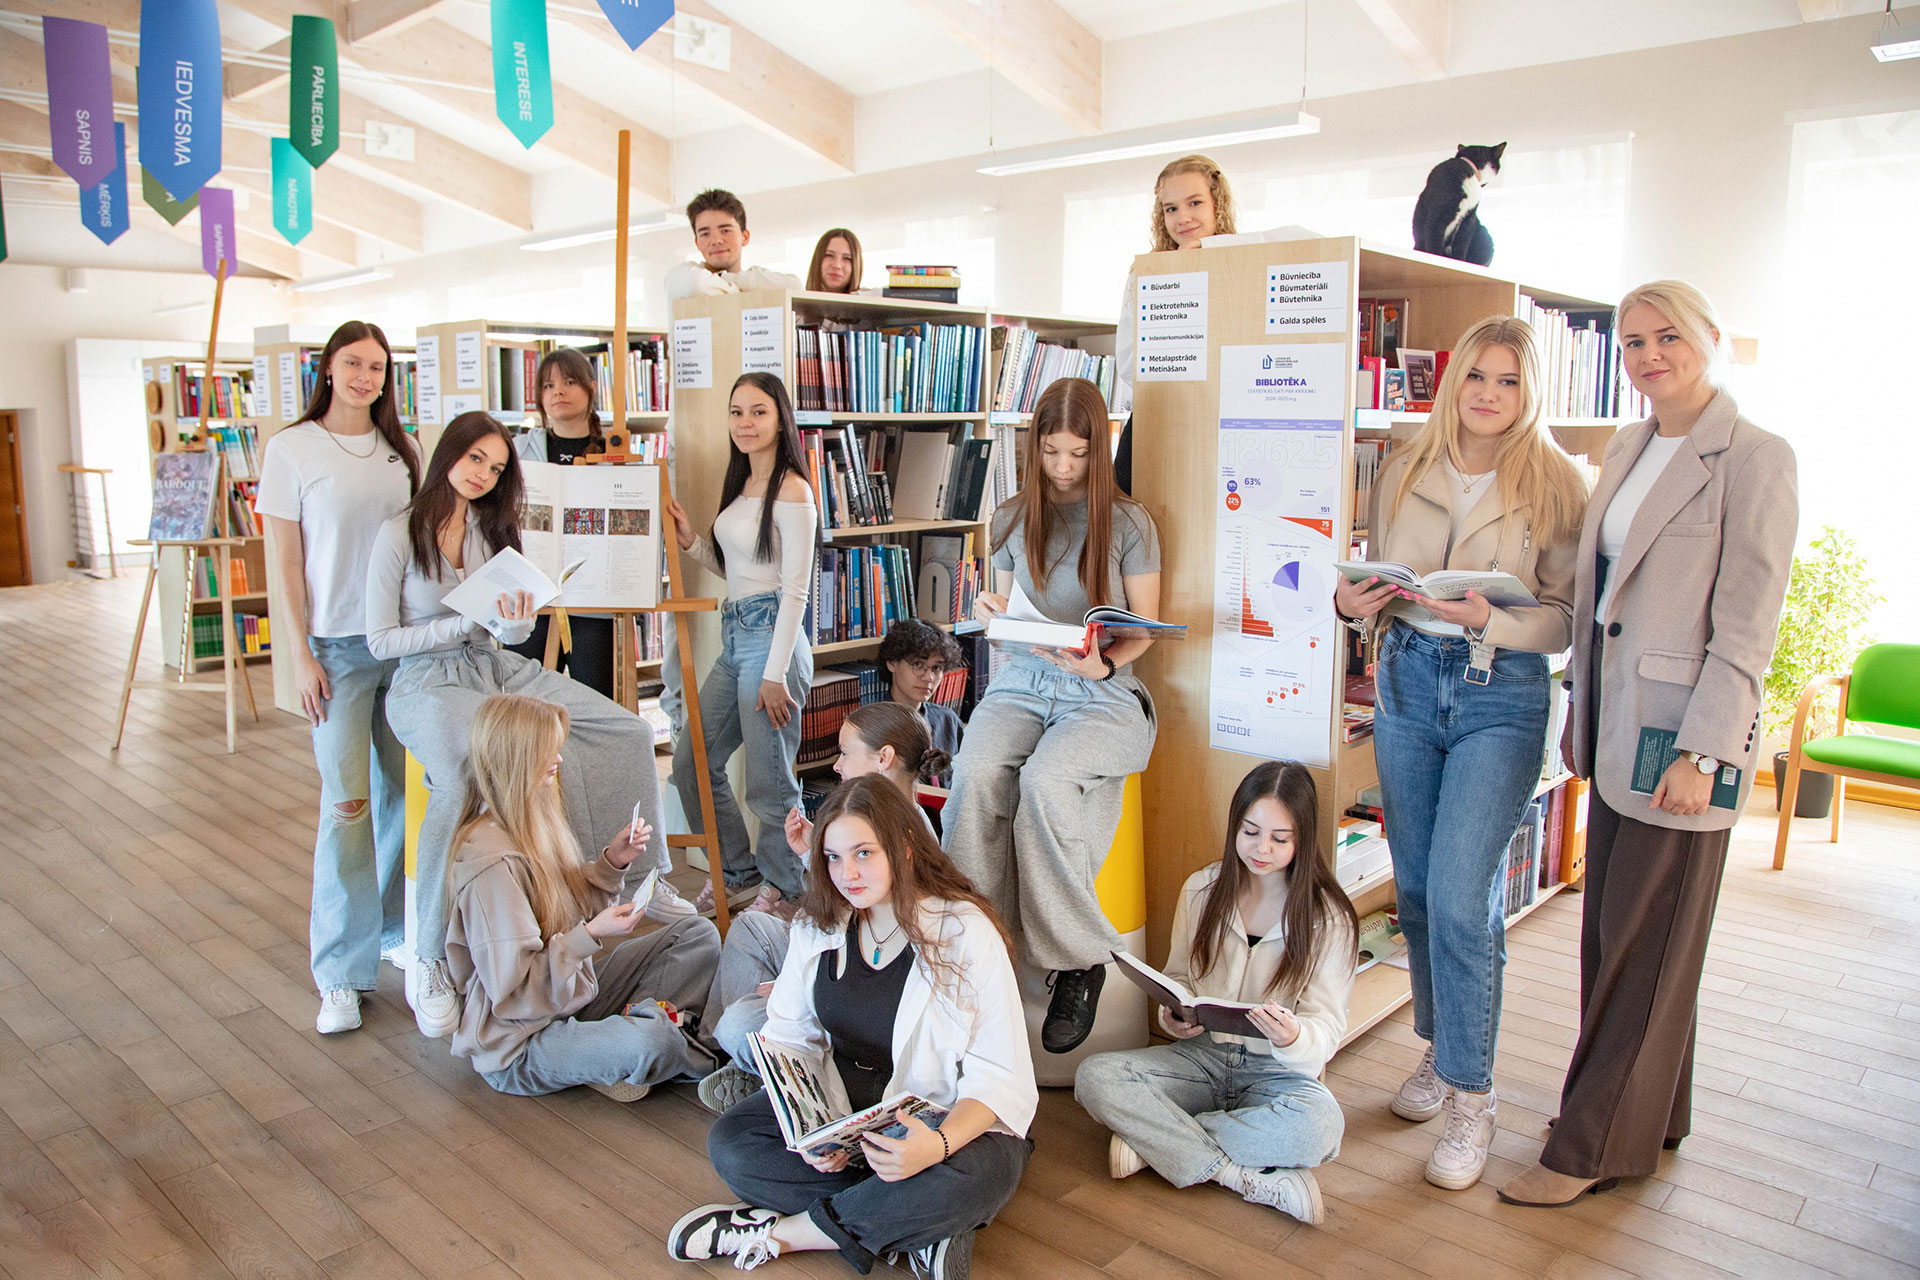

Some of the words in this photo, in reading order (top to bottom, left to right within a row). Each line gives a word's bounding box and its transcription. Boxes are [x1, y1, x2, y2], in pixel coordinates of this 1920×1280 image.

[513, 41, 533, 122] INTERESE
[311, 65, 325, 147] PĀRLIECĪBA
[174, 60, 194, 167] IEDVESMA
[76, 109, 93, 166] SAPNIS
[98, 184, 112, 228] MĒRĶIS
[1280, 271, 1321, 280] Būvniecība
[920, 276, 954, 286] DESIGN
[1151, 282, 1180, 291] Būvdarbi
[1280, 282, 1328, 292] Būvmateriāli
[1279, 294, 1322, 304] Būvtehnika
[1150, 301, 1199, 311] Elektrotehnika
[1150, 312, 1188, 321] Elektronika
[1279, 316, 1301, 325] Galda
[1302, 316, 1327, 326] spēles
[1149, 354, 1197, 364] Metalapstrāde
[1149, 365, 1187, 373] Metināšana
[1255, 377, 1307, 386] BIBLIOTĒKA
[1222, 432, 1338, 470] 18625
[1244, 477, 1261, 486] 63%
